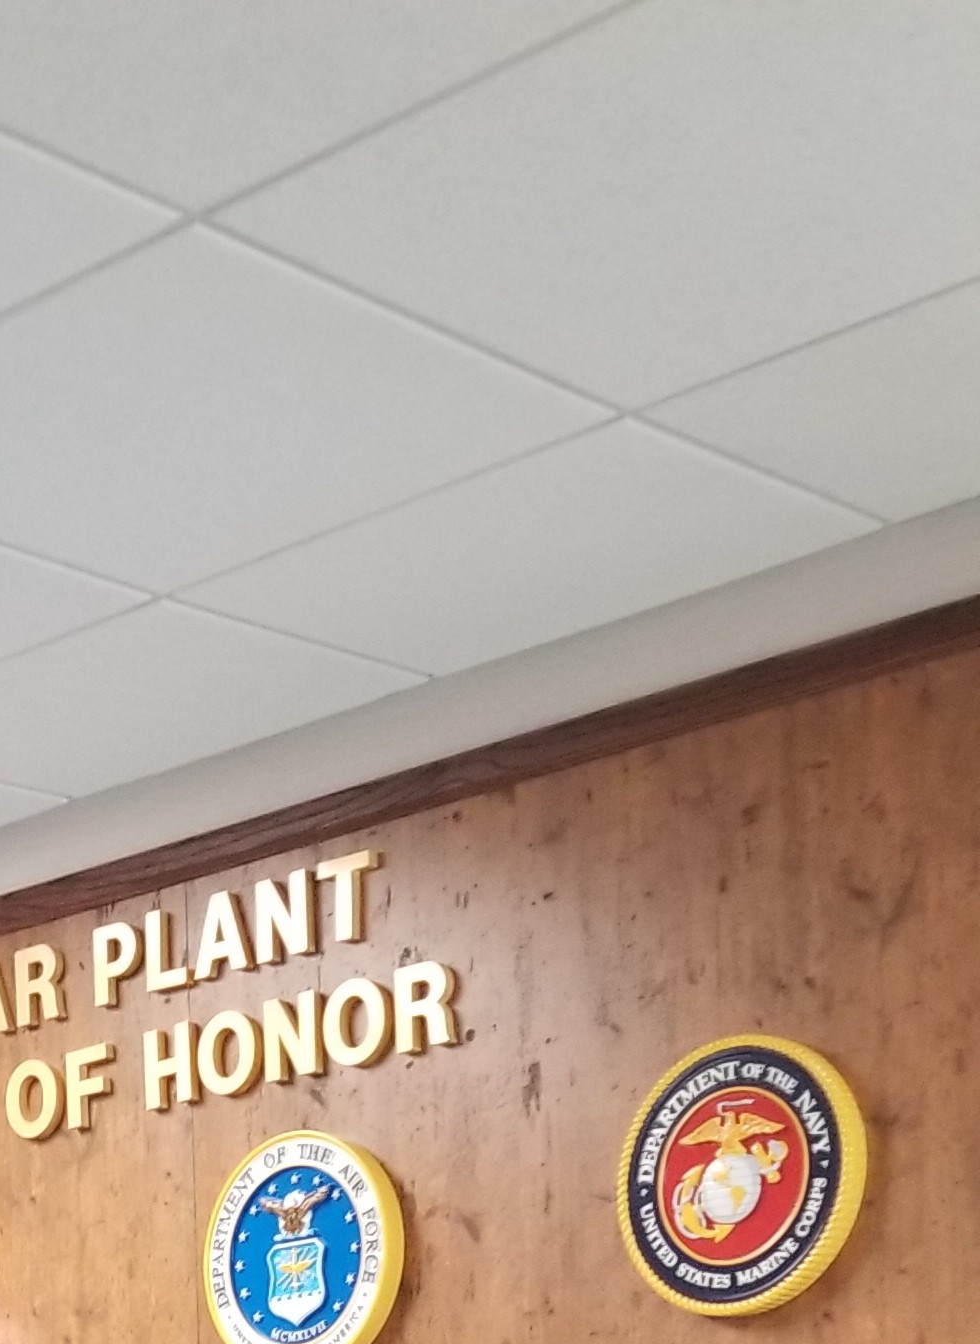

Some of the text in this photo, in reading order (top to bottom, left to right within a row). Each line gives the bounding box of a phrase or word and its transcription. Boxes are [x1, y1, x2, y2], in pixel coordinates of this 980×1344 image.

[92, 849, 379, 1007] PLANT
[4, 1042, 114, 1142] OF
[142, 957, 461, 1112] HONOR
[637, 1061, 831, 1184] DEPARTMENT OF THE NAVY
[212, 1143, 379, 1311] DEPARTMENT OF THE AIR FORCE
[640, 1177, 827, 1289] UNITED STATES MARINE CORPS
